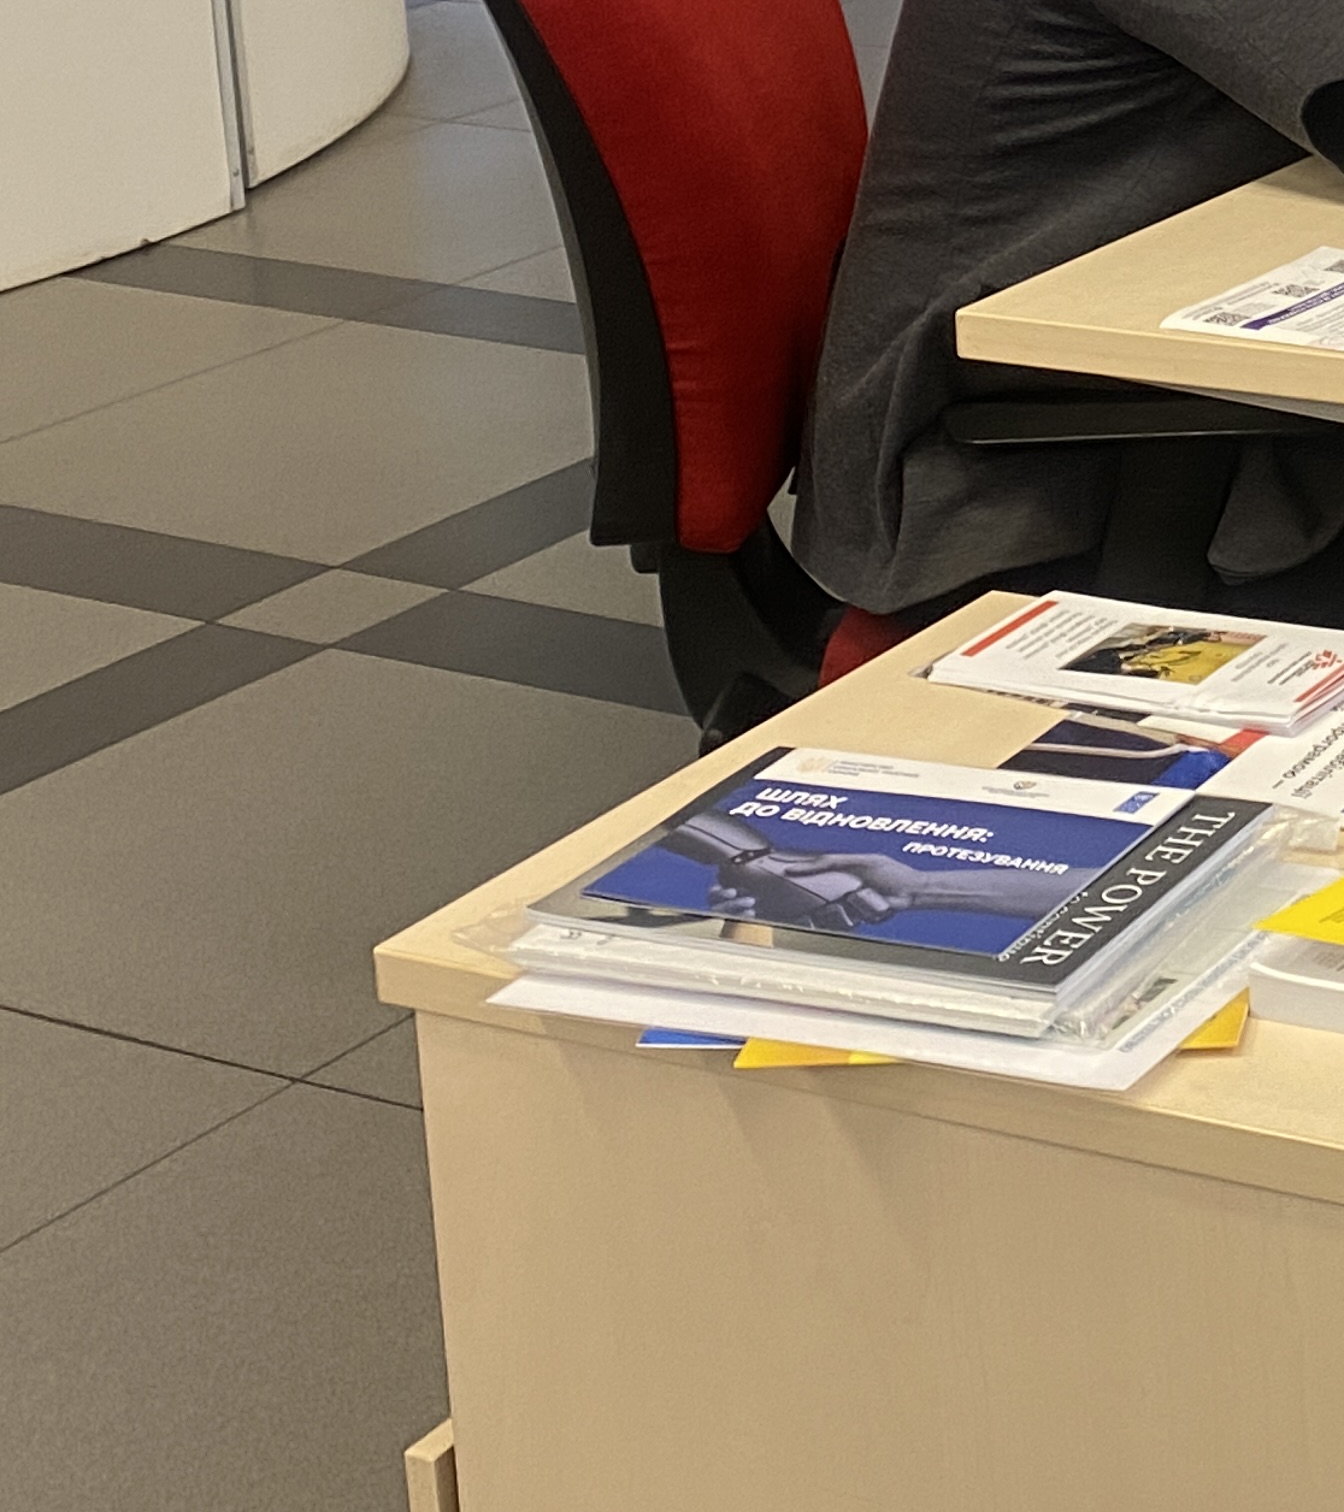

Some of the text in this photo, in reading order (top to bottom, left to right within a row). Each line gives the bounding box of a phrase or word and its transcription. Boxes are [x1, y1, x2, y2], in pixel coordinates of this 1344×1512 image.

[755, 787, 849, 811] ШЛЯХ
[728, 800, 996, 844] ДО ВІДНОВЛЕННЯ:
[902, 841, 1070, 876] ПРОТЕЗУВАННЯ
[1019, 810, 1236, 966] THE POWER
